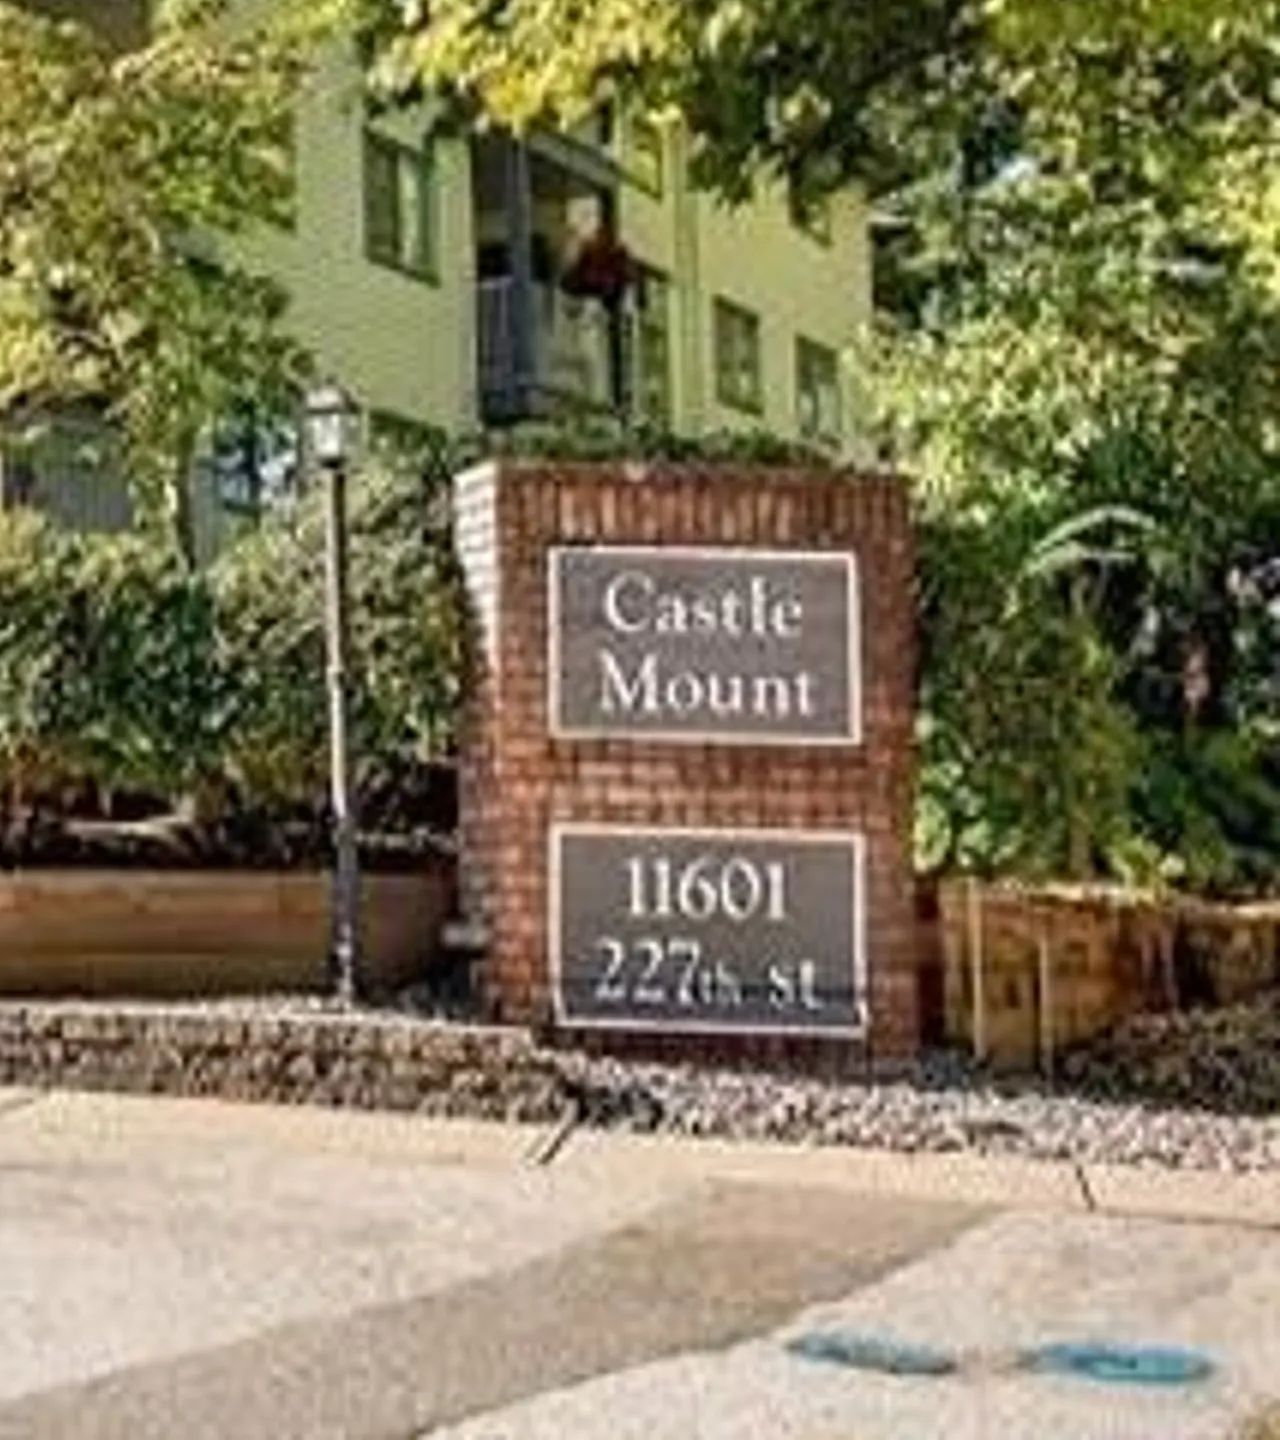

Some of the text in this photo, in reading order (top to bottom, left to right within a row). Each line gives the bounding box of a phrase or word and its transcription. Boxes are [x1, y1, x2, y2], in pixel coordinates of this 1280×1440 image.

[603, 571, 803, 638] Castle
[598, 649, 815, 716] Mount
[625, 857, 786, 920] 11601
[594, 938, 742, 1007] 227th
